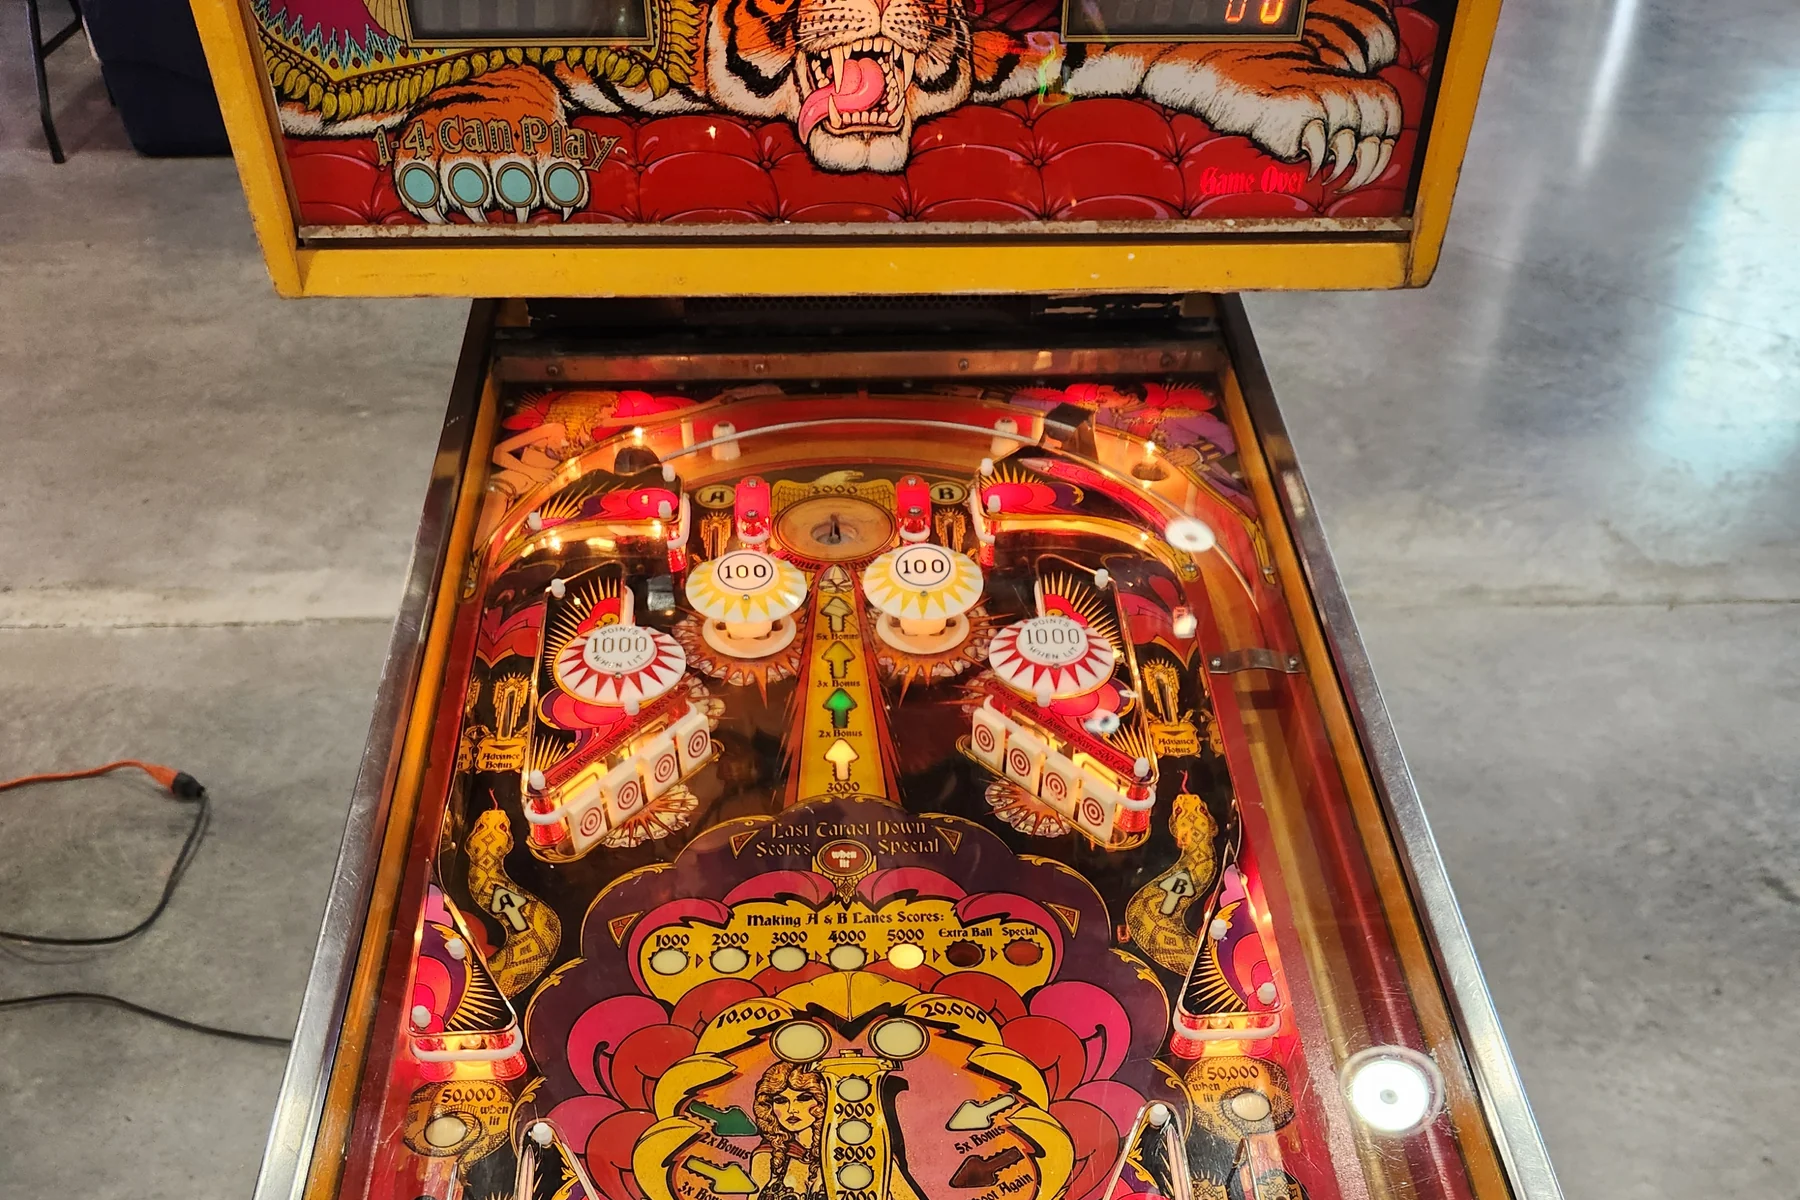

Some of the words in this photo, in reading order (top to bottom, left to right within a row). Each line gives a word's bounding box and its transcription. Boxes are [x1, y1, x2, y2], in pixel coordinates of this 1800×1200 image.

[519, 115, 621, 173] Play
[1200, 166, 1255, 194] Game
[1261, 165, 1306, 194] Over
[710, 490, 727, 503] A
[937, 487, 954, 500] B
[724, 564, 767, 579] 100
[902, 559, 945, 574] 100
[1032, 618, 1070, 628] POINTS
[600, 626, 639, 637] POINTS
[1026, 628, 1080, 645] 1000
[592, 636, 648, 654] 1000
[816, 680, 829, 688] 3x
[832, 679, 861, 687] Bonus
[818, 730, 831, 738] 2x
[833, 729, 863, 737] Bonus
[1158, 737, 1195, 745] Advance
[1164, 746, 1191, 754] Bonus
[826, 782, 861, 793] 3000
[771, 822, 810, 838] Last
[816, 822, 870, 838] Target
[877, 820, 928, 836] Down
[756, 840, 812, 857] Scores
[877, 838, 940, 855] Special
[1170, 877, 1188, 895] B
[498, 893, 516, 911] A
[747, 913, 802, 927] Making
[805, 912, 819, 925] A
[823, 914, 834, 925] &
[837, 912, 848, 925] B
[852, 912, 893, 924] Lanes
[897, 910, 945, 923] Scores:
[711, 932, 749, 945] 2000
[771, 931, 808, 944] 3000
[828, 930, 867, 943] 4000
[886, 928, 925, 942] 5000
[938, 927, 968, 938] Extra
[971, 927, 993, 937] Ball
[1001, 926, 1039, 937] Special
[655, 933, 690, 947] 1000
[716, 1005, 782, 1029] 10,000
[920, 1001, 987, 1025] 20,000
[1206, 1065, 1260, 1082] 50,000
[1192, 1081, 1221, 1092] when
[441, 1087, 496, 1104] 50,000
[1203, 1092, 1215, 1103] lit
[479, 1104, 509, 1117] when
[833, 1102, 876, 1119] 9000
[489, 1116, 501, 1126] lit
[699, 1131, 715, 1147] 2x
[716, 1136, 752, 1160] Bonus
[954, 1142, 975, 1155] 5x
[968, 1125, 1007, 1148] Bonus
[833, 1145, 876, 1161] 8000
[677, 1181, 695, 1197] 3x
[996, 1173, 1034, 1197] Again
